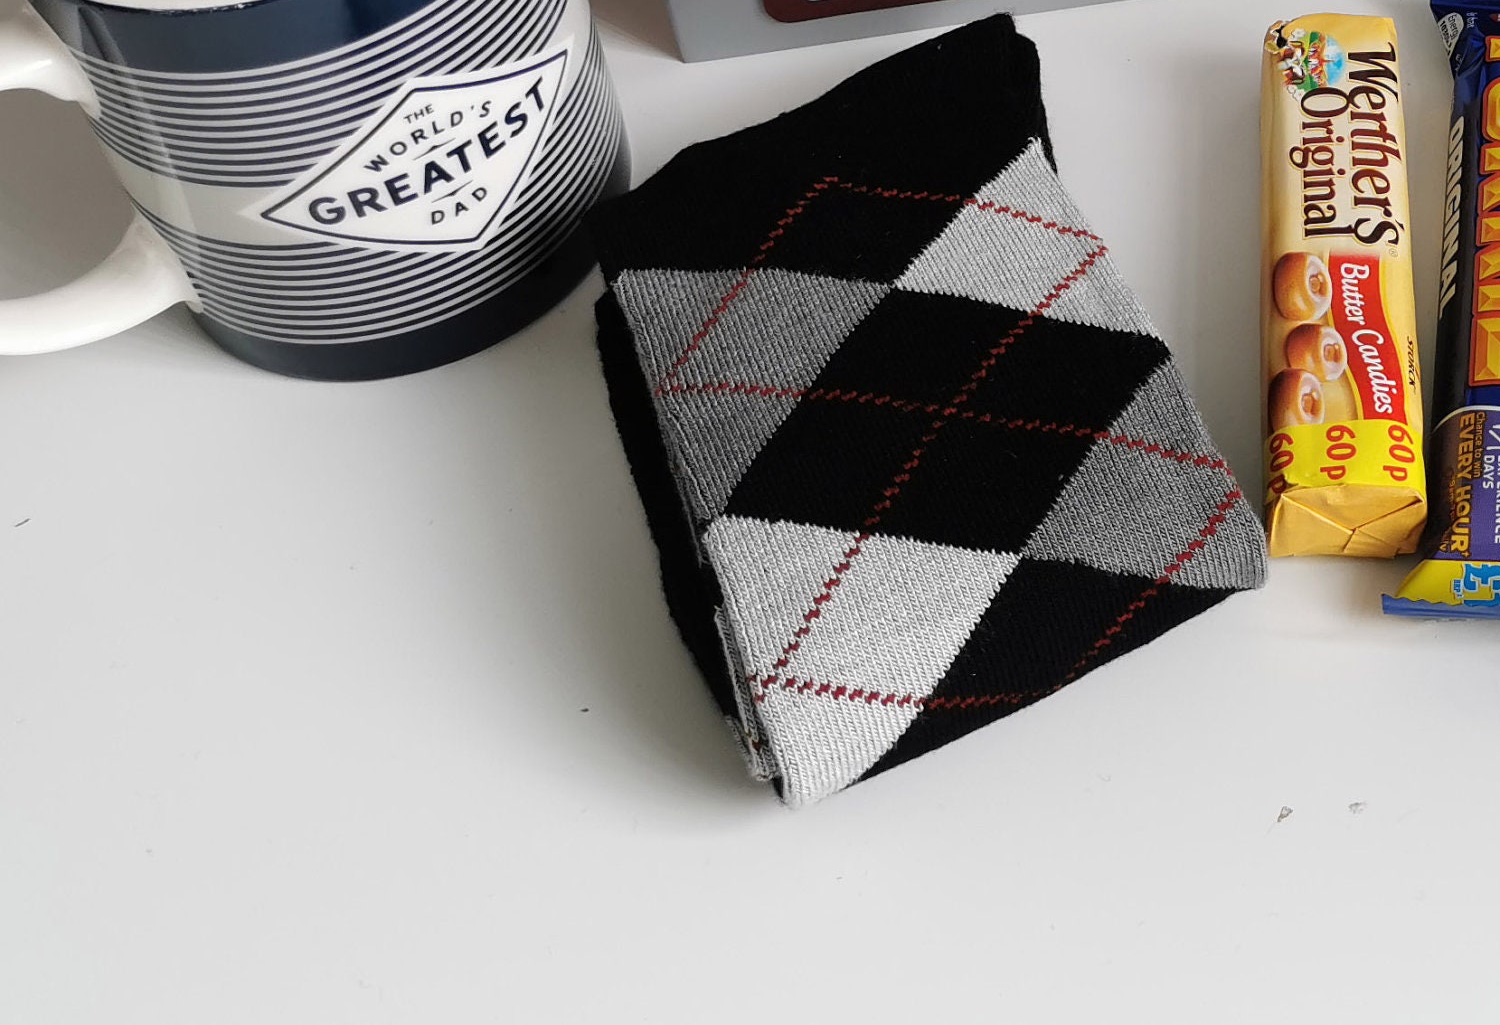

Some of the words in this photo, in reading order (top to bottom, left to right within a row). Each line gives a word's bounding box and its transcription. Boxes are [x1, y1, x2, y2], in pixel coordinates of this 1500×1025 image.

[363, 99, 493, 173] WORLD'S
[403, 104, 434, 125] THE
[1347, 41, 1405, 247] Werther's
[308, 76, 546, 225] GREATEST
[1289, 86, 1357, 238] Original
[430, 186, 488, 226] DAD
[1439, 115, 1464, 319] ORIGINAL
[1340, 261, 1370, 326] Butter
[1351, 328, 1400, 415] Candies
[1320, 424, 1357, 481] 60p
[1383, 424, 1415, 482] 60p
[1457, 412, 1475, 478] EVERY
[1474, 447, 1483, 459] to
[1476, 411, 1486, 445] Chance
[1267, 431, 1295, 495] 60p
[1473, 459, 1482, 478] win
[1482, 454, 1494, 489] DAYS
